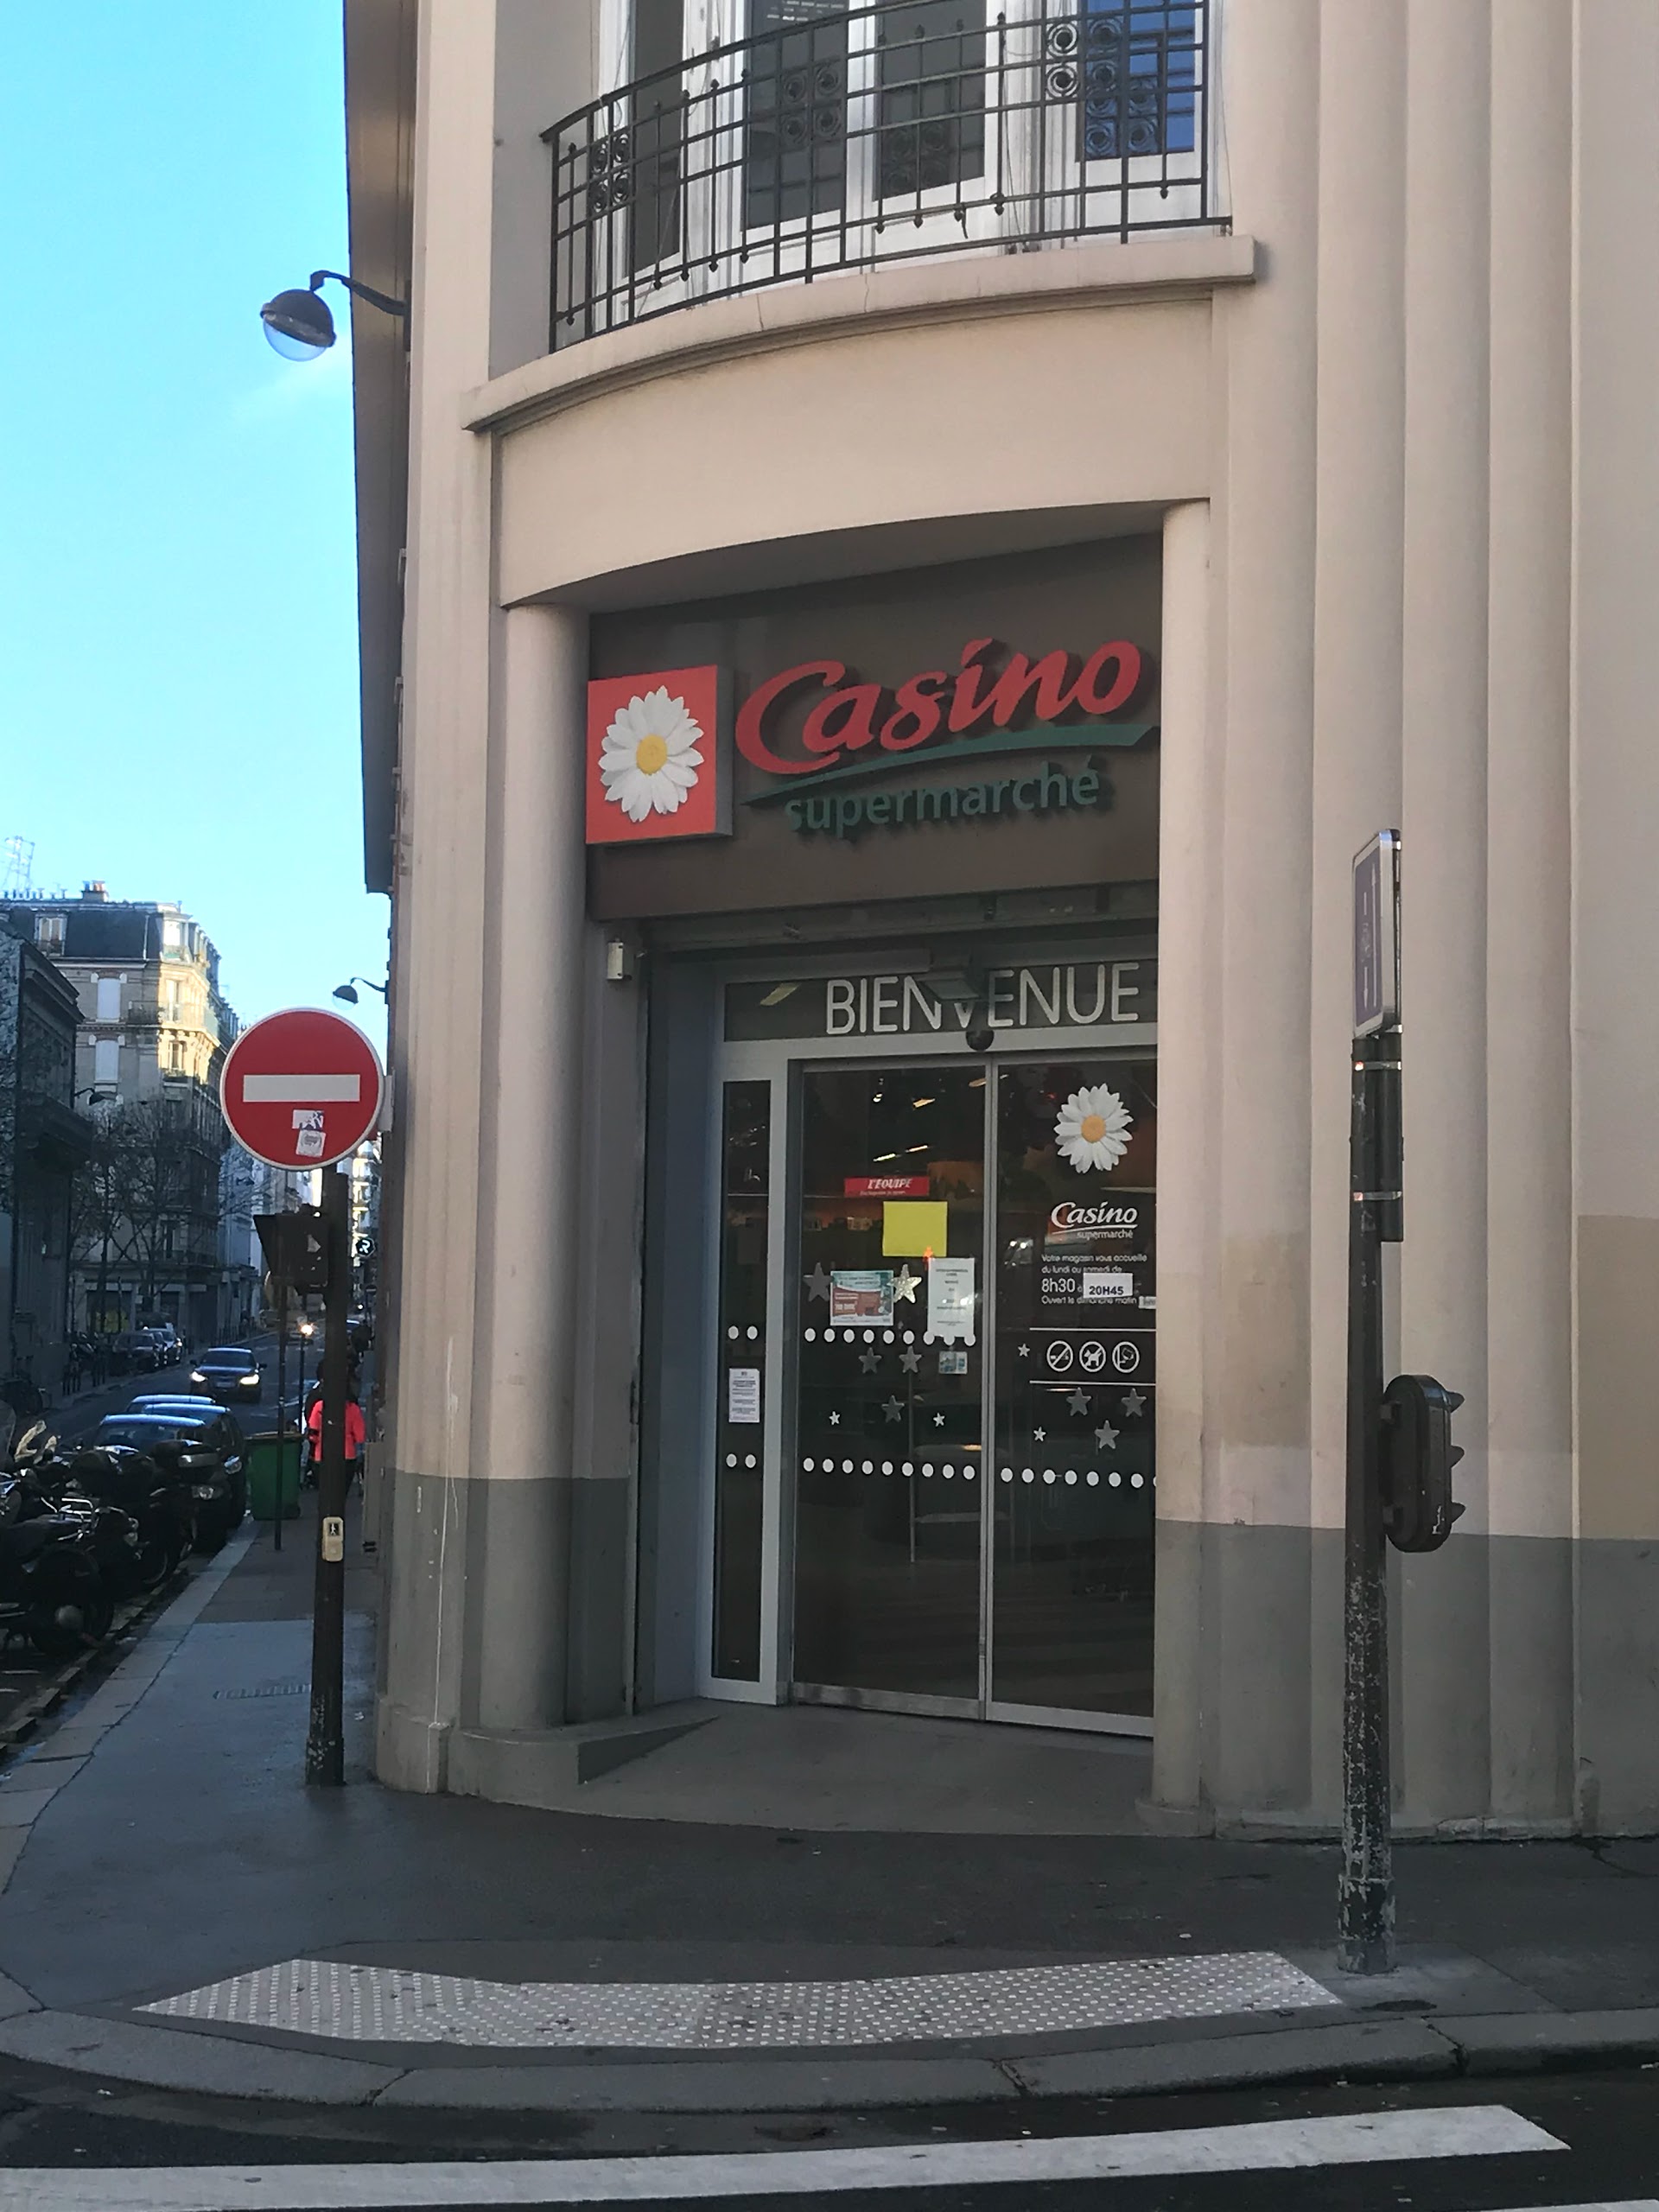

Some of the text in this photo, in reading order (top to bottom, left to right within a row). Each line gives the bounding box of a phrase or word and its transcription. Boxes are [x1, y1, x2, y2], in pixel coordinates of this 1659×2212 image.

[735, 638, 1141, 774] Casino
[784, 754, 1102, 838] supermarché
[1051, 1201, 1138, 1229] Casino
[1077, 1230, 1134, 1241] supermarché
[1062, 1255, 1094, 1264] magasin
[1041, 1278, 1076, 1293] 8h30
[1089, 1286, 1124, 1295] 20H45
[1041, 1295, 1065, 1304] Ouvert
[1067, 1295, 1075, 1304] le
